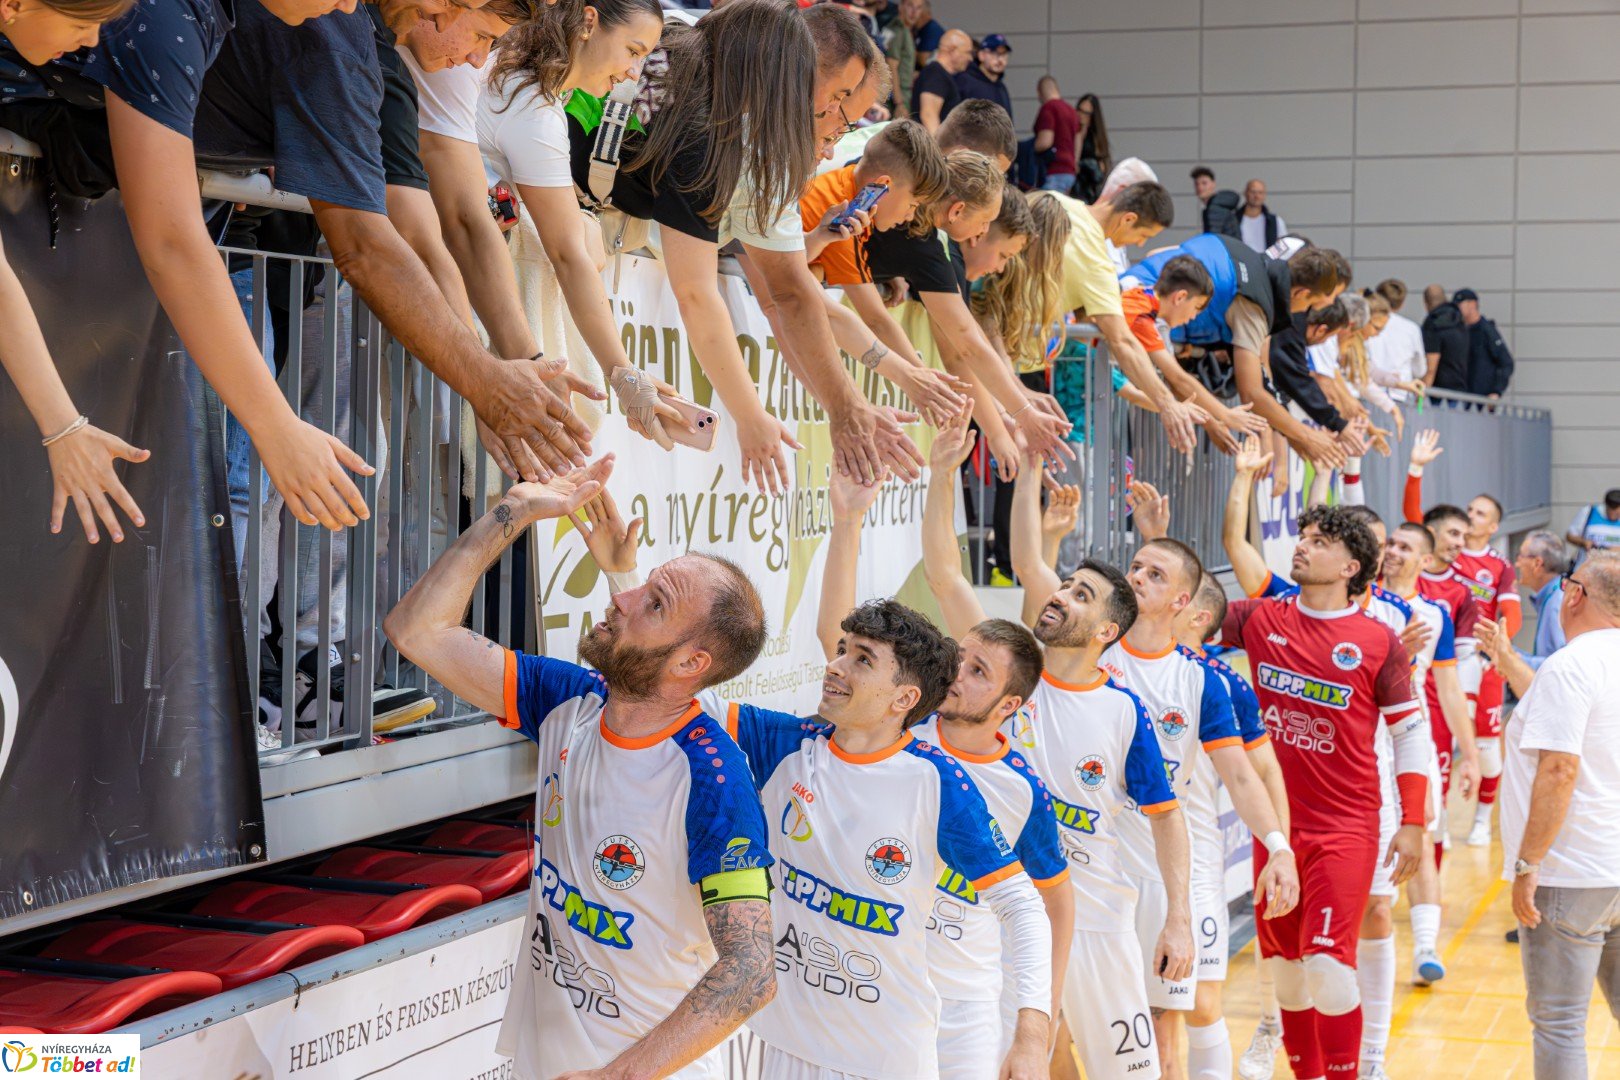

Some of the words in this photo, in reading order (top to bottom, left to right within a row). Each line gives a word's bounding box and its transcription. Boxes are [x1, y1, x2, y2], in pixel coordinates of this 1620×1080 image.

[631, 493, 656, 547] a
[792, 781, 814, 804] JAKO
[602, 837, 640, 858] FUTSAL
[873, 839, 908, 855] FUTSAL
[1201, 916, 1218, 949] 9
[1320, 906, 1333, 936] 1
[1200, 957, 1220, 966] JAKO
[775, 951, 881, 1003] STUDIO
[289, 1019, 372, 1073] HELYBEN
[376, 1003, 393, 1042] ÉS
[396, 985, 464, 1033] FRISSEN
[1111, 1012, 1151, 1056] 20
[1127, 1059, 1151, 1072] JAKO
